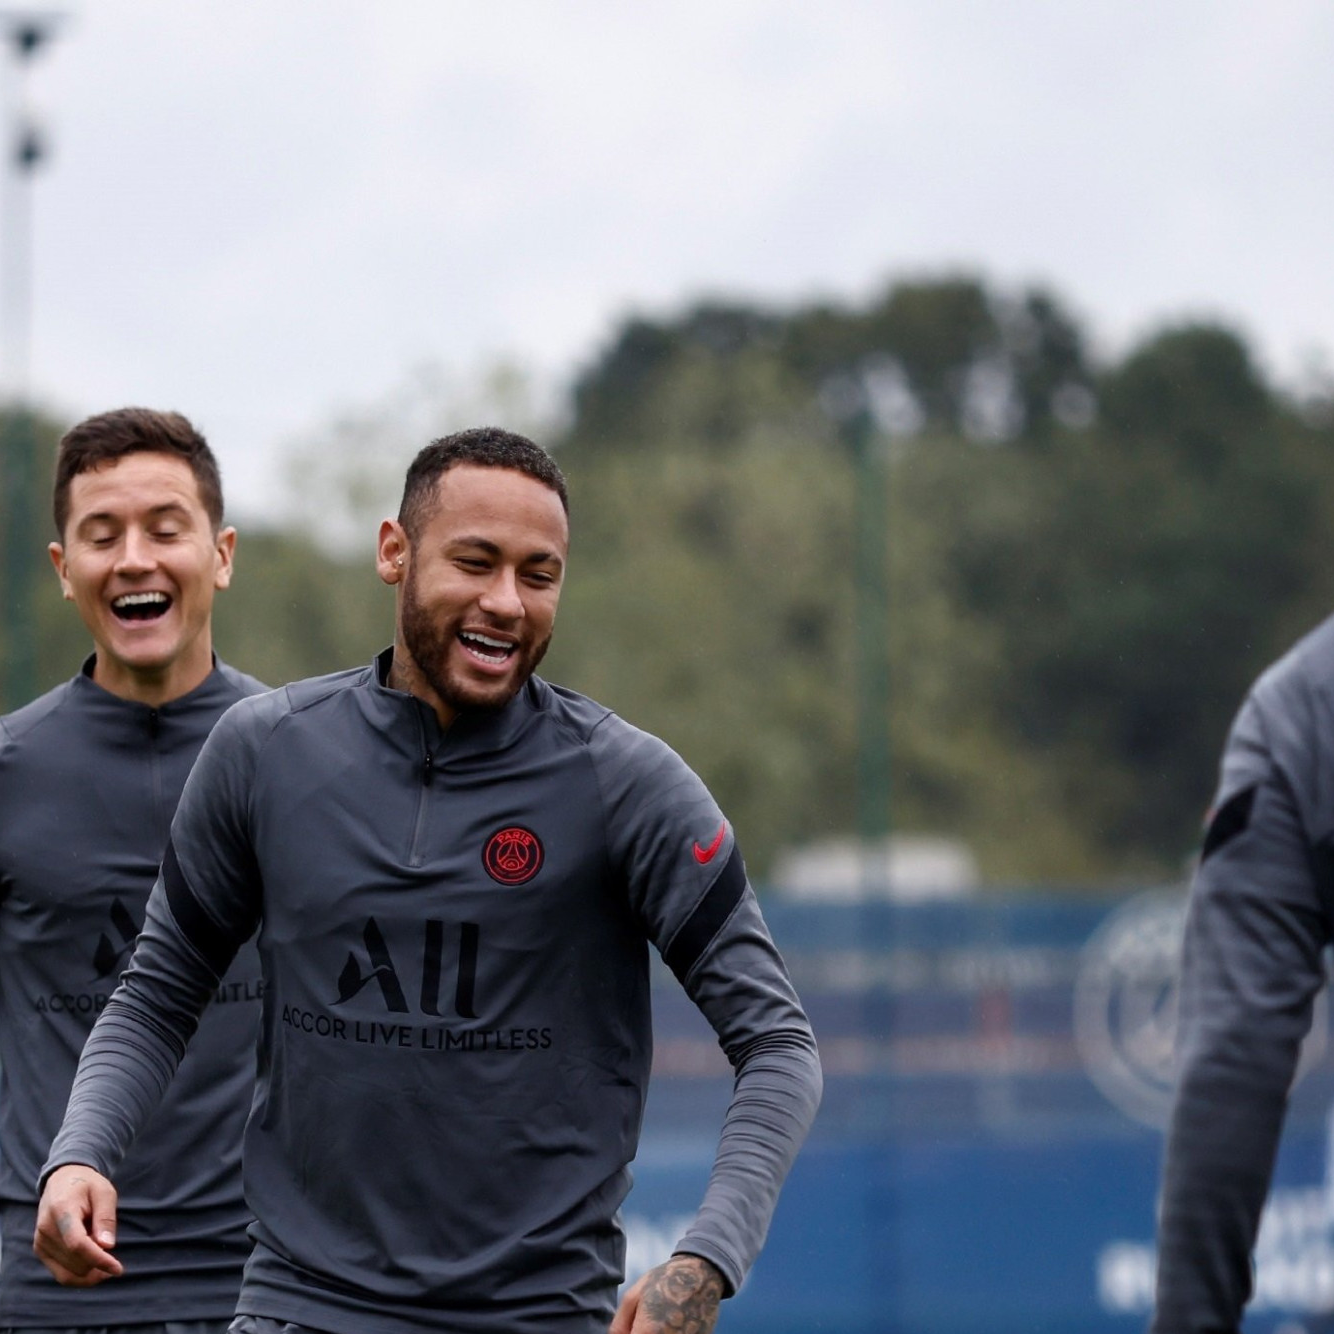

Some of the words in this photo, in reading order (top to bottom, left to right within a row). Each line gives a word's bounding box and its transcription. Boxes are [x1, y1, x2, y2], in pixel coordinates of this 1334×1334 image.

[496, 831, 532, 846] PARIS
[282, 1004, 347, 1041] ACCOR
[355, 1021, 413, 1048] LIVE
[422, 1027, 553, 1051] LIMITLESS
